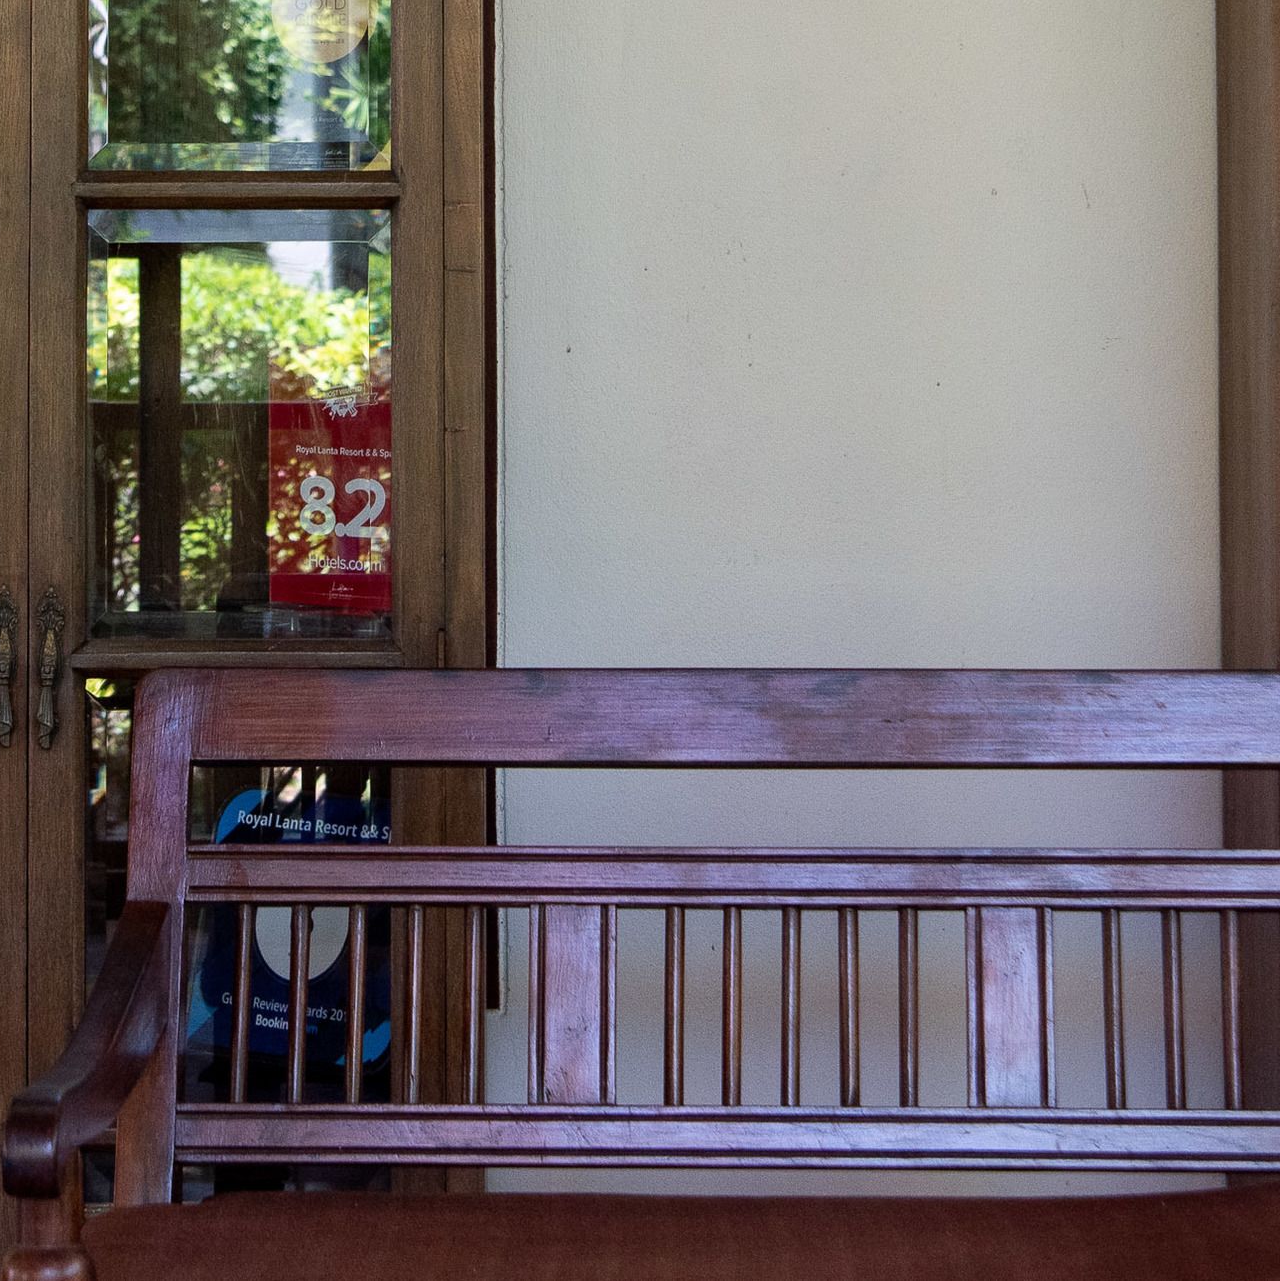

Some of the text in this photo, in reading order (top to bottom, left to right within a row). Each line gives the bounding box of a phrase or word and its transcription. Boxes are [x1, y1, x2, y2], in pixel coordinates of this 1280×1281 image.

[295, 444, 364, 457] Royal Lanta Resort
[299, 475, 389, 538] 8.2
[238, 810, 357, 839] Royal Lanta Resort
[253, 996, 289, 1013] Review
